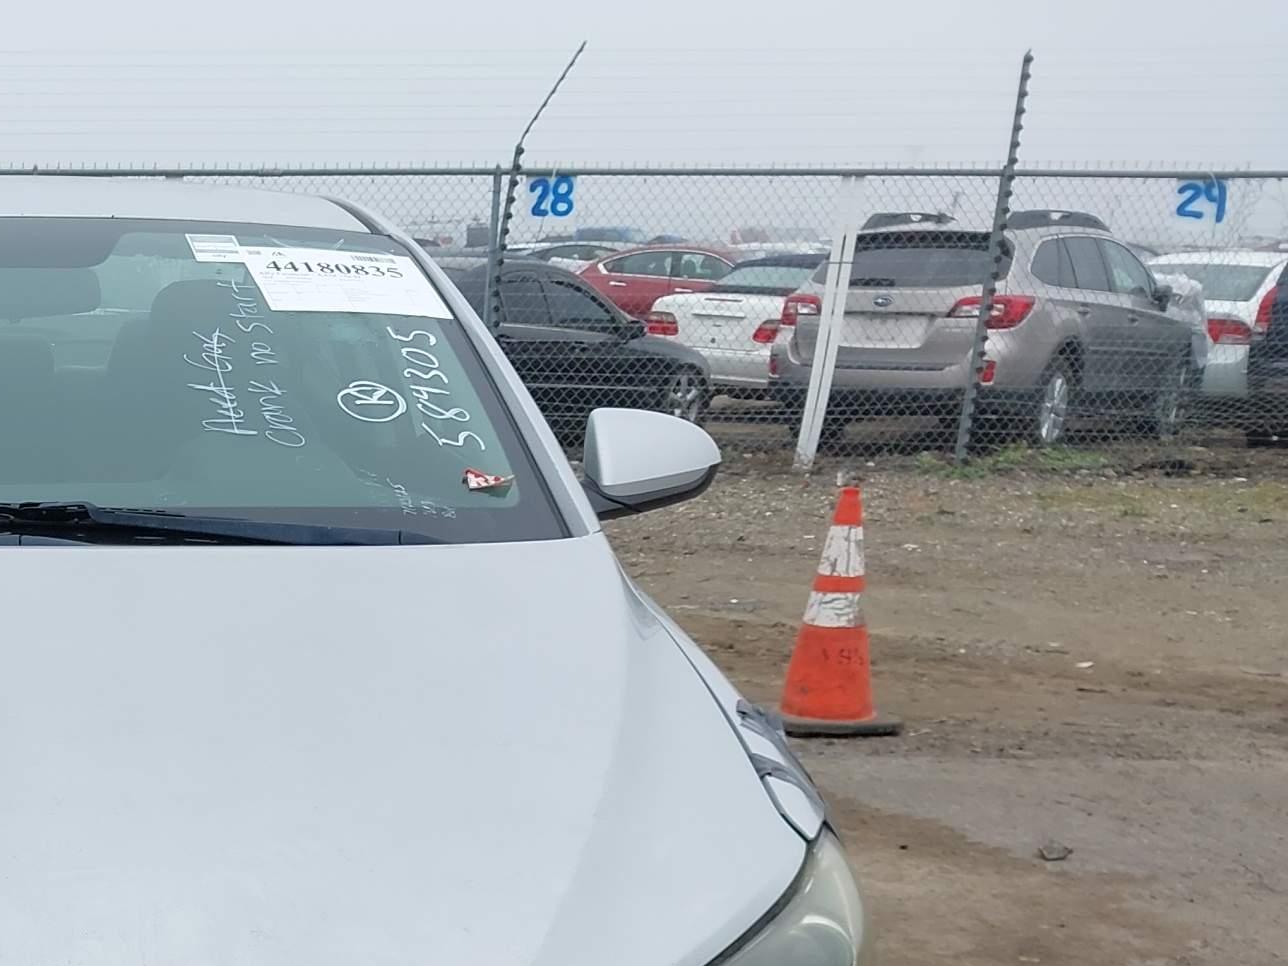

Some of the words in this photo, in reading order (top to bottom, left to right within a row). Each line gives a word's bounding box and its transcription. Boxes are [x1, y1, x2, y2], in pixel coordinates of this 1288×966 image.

[529, 175, 574, 217] 28
[1176, 180, 1227, 223] 29
[265, 259, 404, 280] 44180835
[250, 341, 280, 365] no
